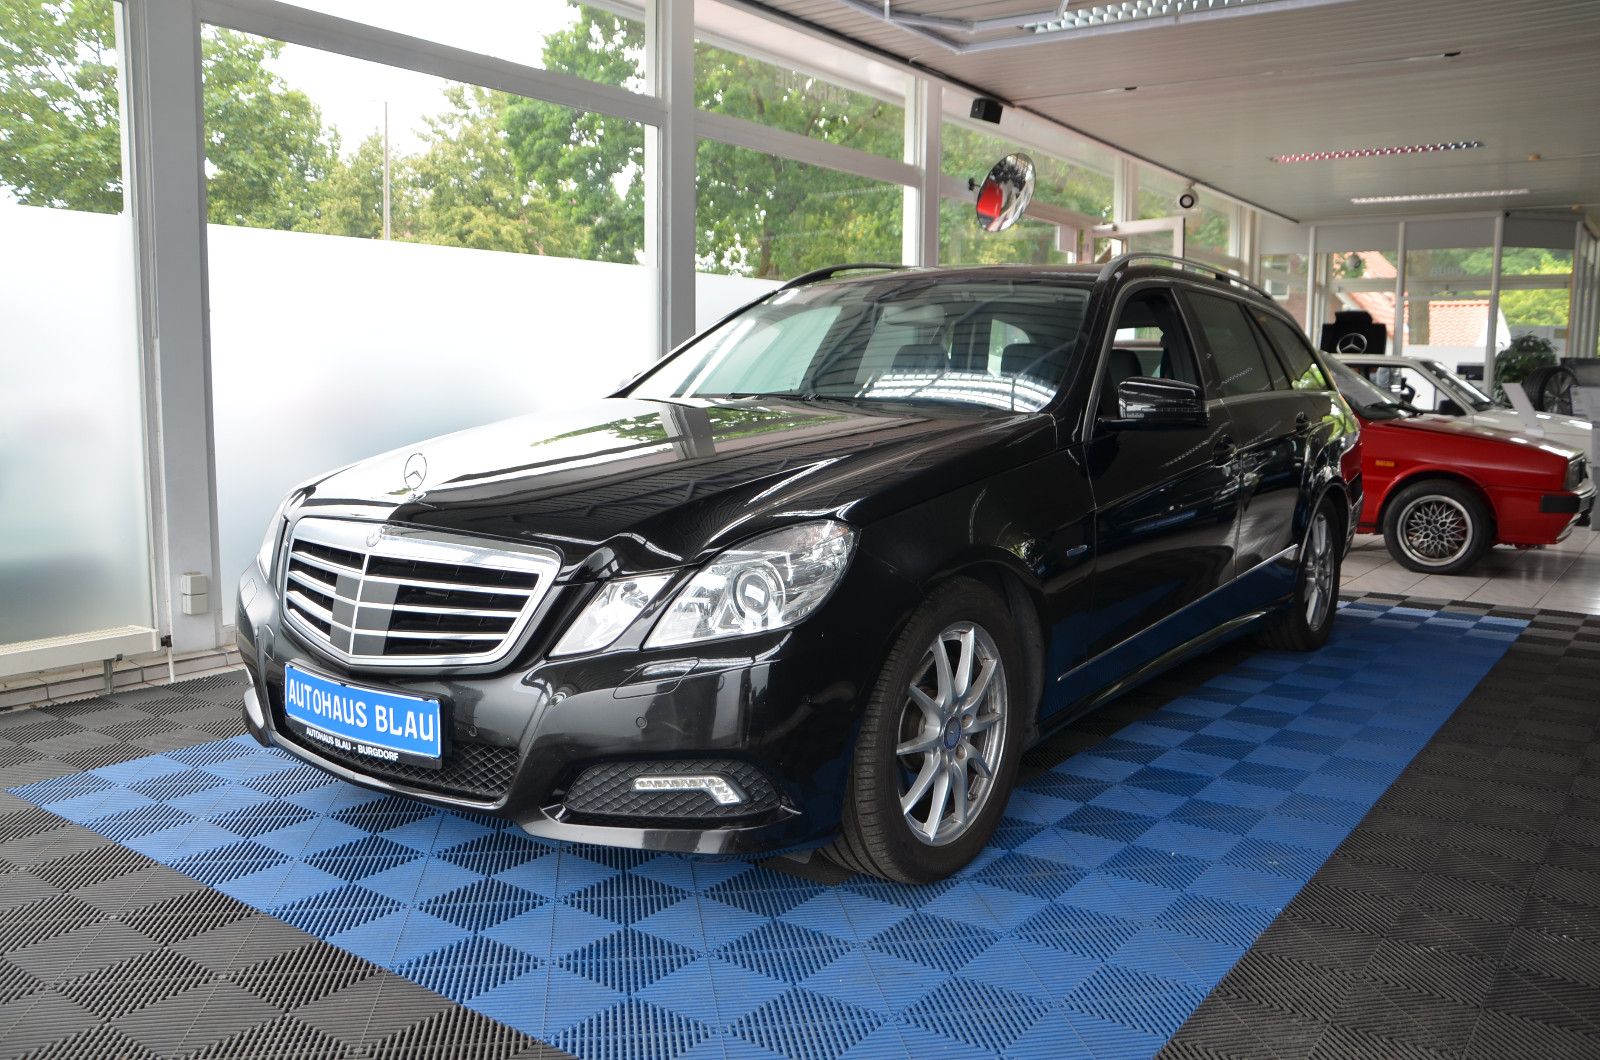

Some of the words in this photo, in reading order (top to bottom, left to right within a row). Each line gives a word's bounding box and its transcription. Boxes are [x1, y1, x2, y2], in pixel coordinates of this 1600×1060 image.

[288, 678, 368, 728] AUTOHAUS
[375, 704, 434, 742] BLAU
[306, 727, 334, 745] AUTOHAUS
[335, 737, 351, 751] BLAU
[358, 744, 399, 762] BURGDORF
